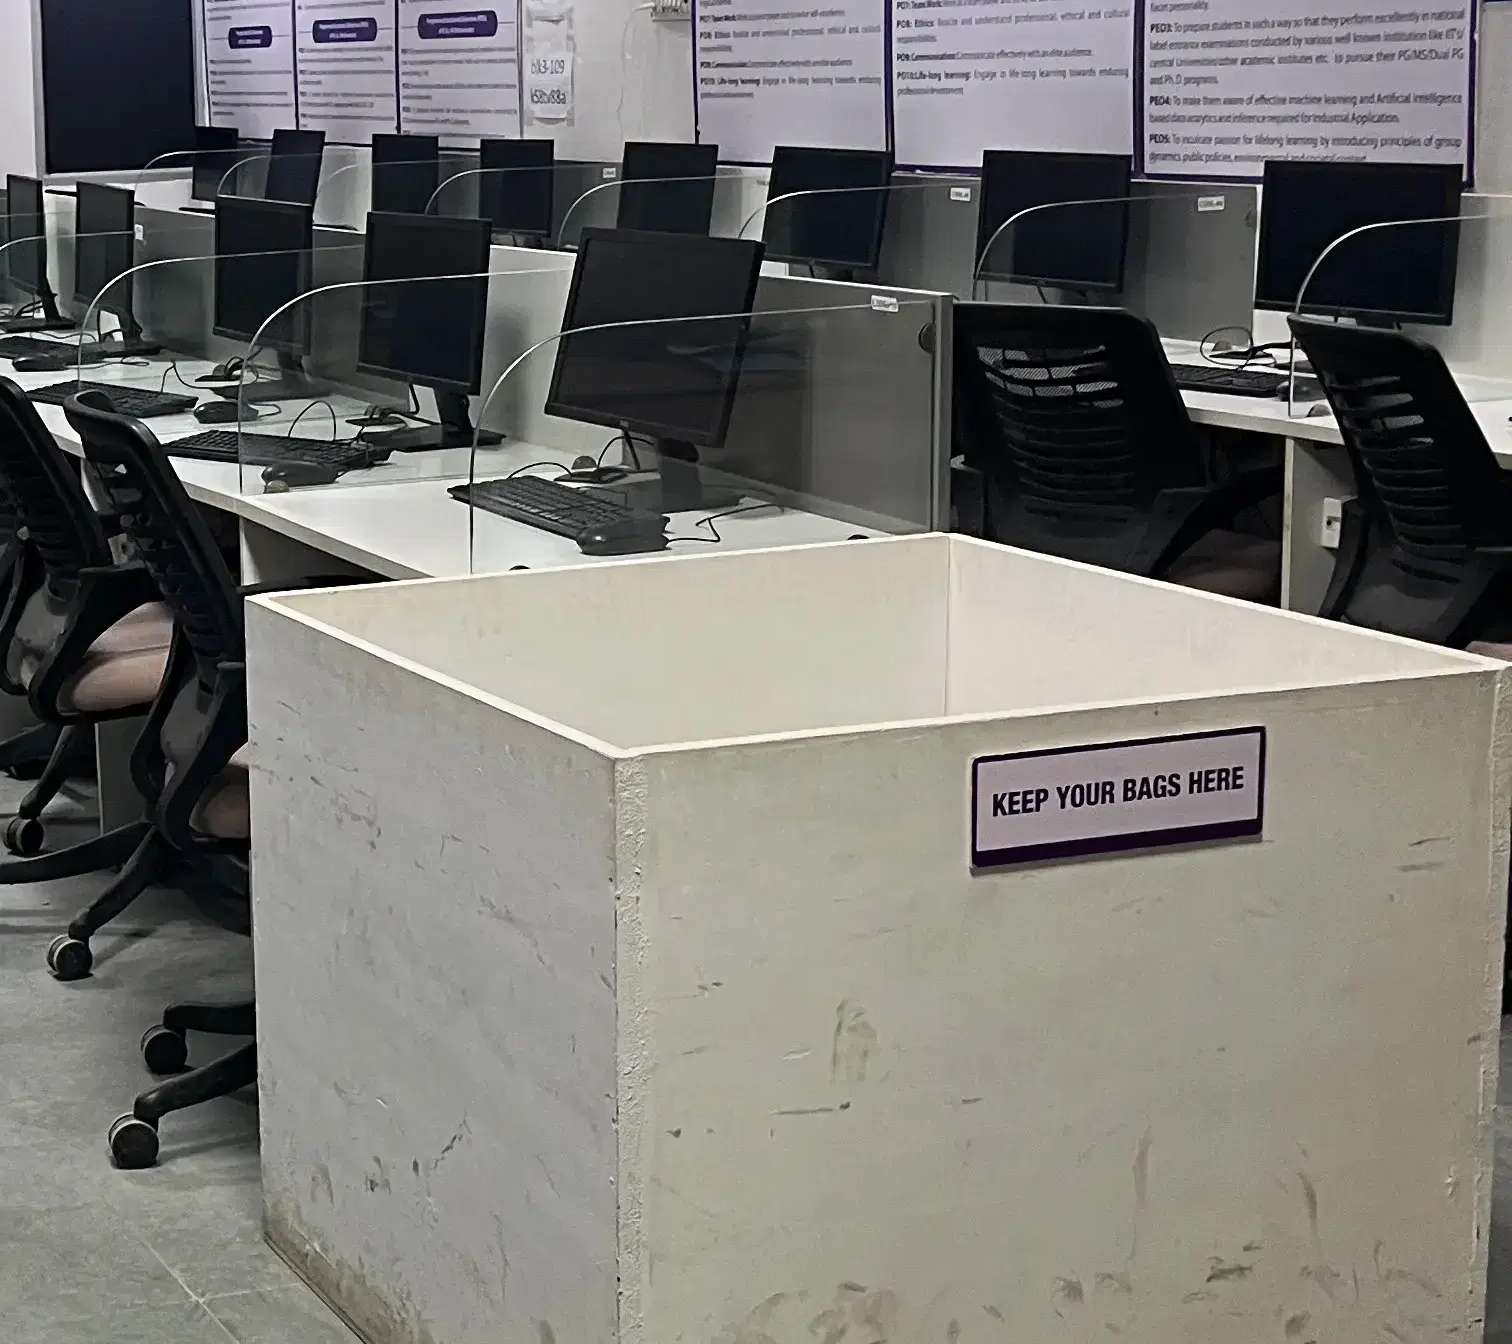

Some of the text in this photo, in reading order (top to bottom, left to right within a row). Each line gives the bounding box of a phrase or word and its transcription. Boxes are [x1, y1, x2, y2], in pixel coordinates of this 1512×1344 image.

[1150, 23, 1173, 34] PEO3:
[1149, 95, 1172, 106] PEO4:
[1149, 134, 1172, 145] PEO5:
[992, 766, 1244, 817] KEEP YOUR BAGS HERE
